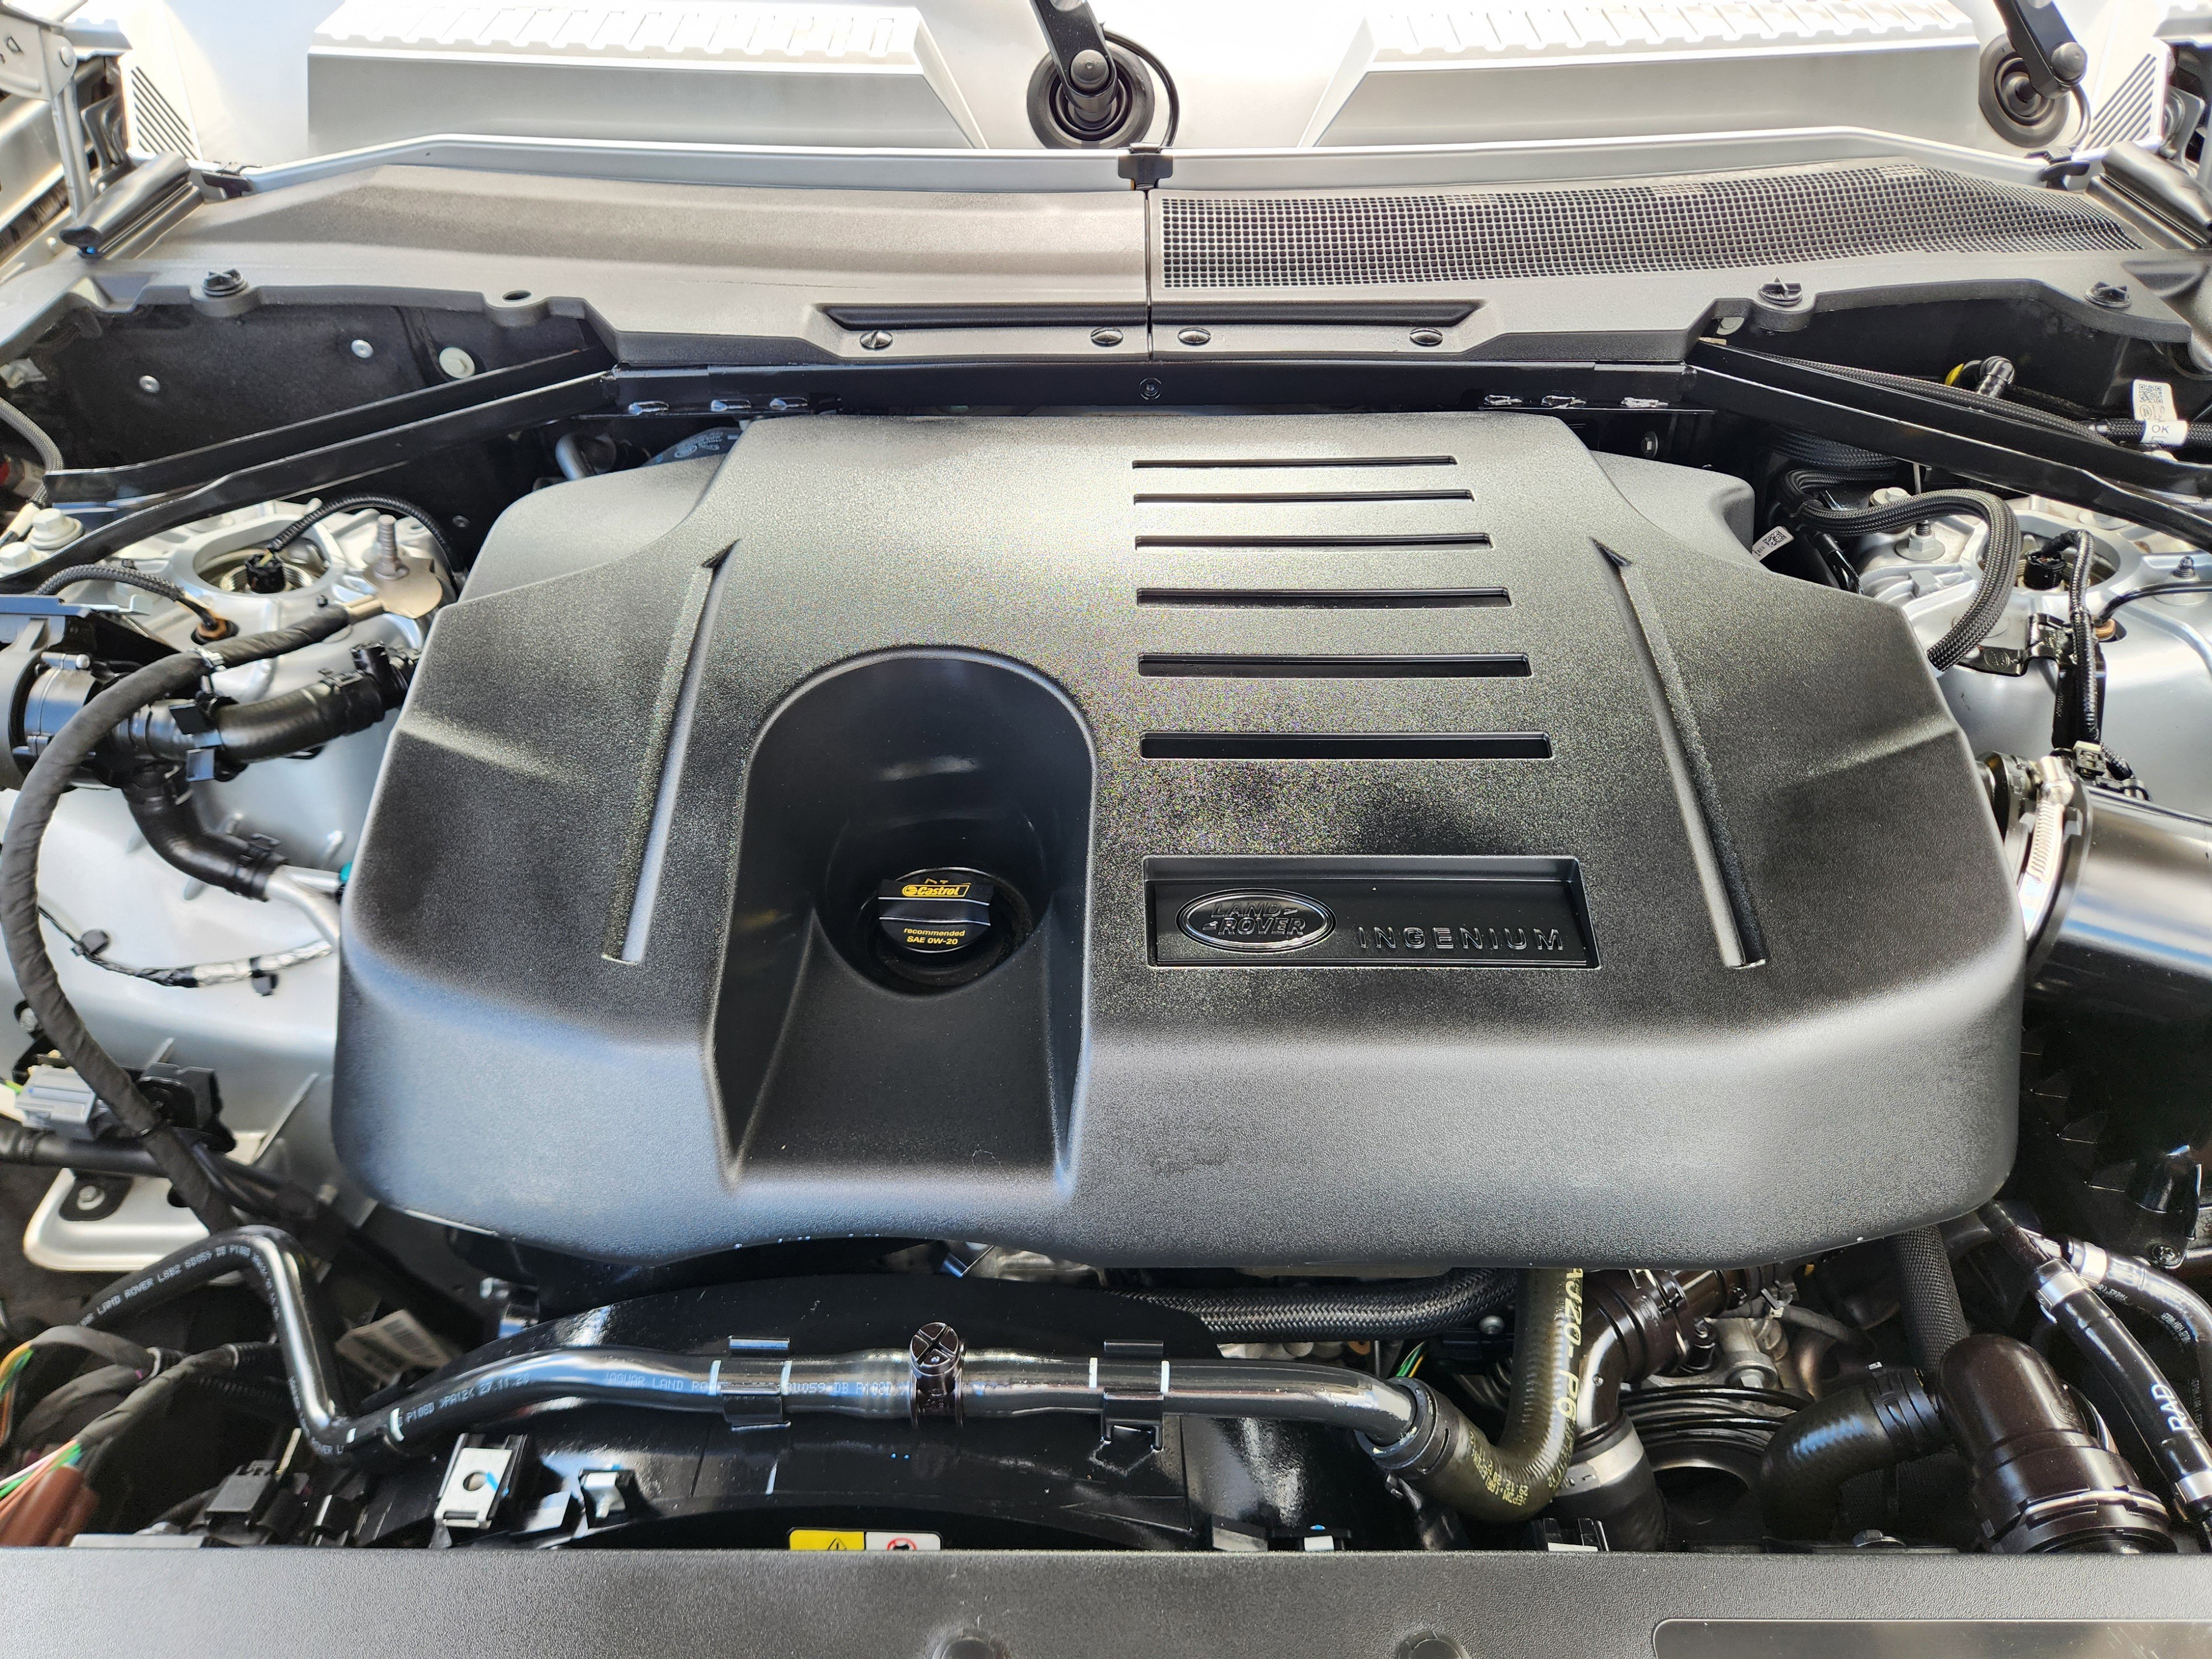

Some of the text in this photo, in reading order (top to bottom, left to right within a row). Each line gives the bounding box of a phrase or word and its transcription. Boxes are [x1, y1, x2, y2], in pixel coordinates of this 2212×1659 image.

[2151, 424, 2171, 434] OK
[917, 886, 961, 896] Castrol
[1211, 901, 1281, 918] LAND
[903, 927, 966, 937] recommended
[1218, 917, 1306, 935] ROVER
[906, 935, 958, 945] SAE 0W-20
[1359, 926, 1564, 951] INGENIUM
[96, 1294, 122, 1316] LAND
[653, 1377, 684, 1391] LAND
[2151, 1384, 2194, 1432] RAD
